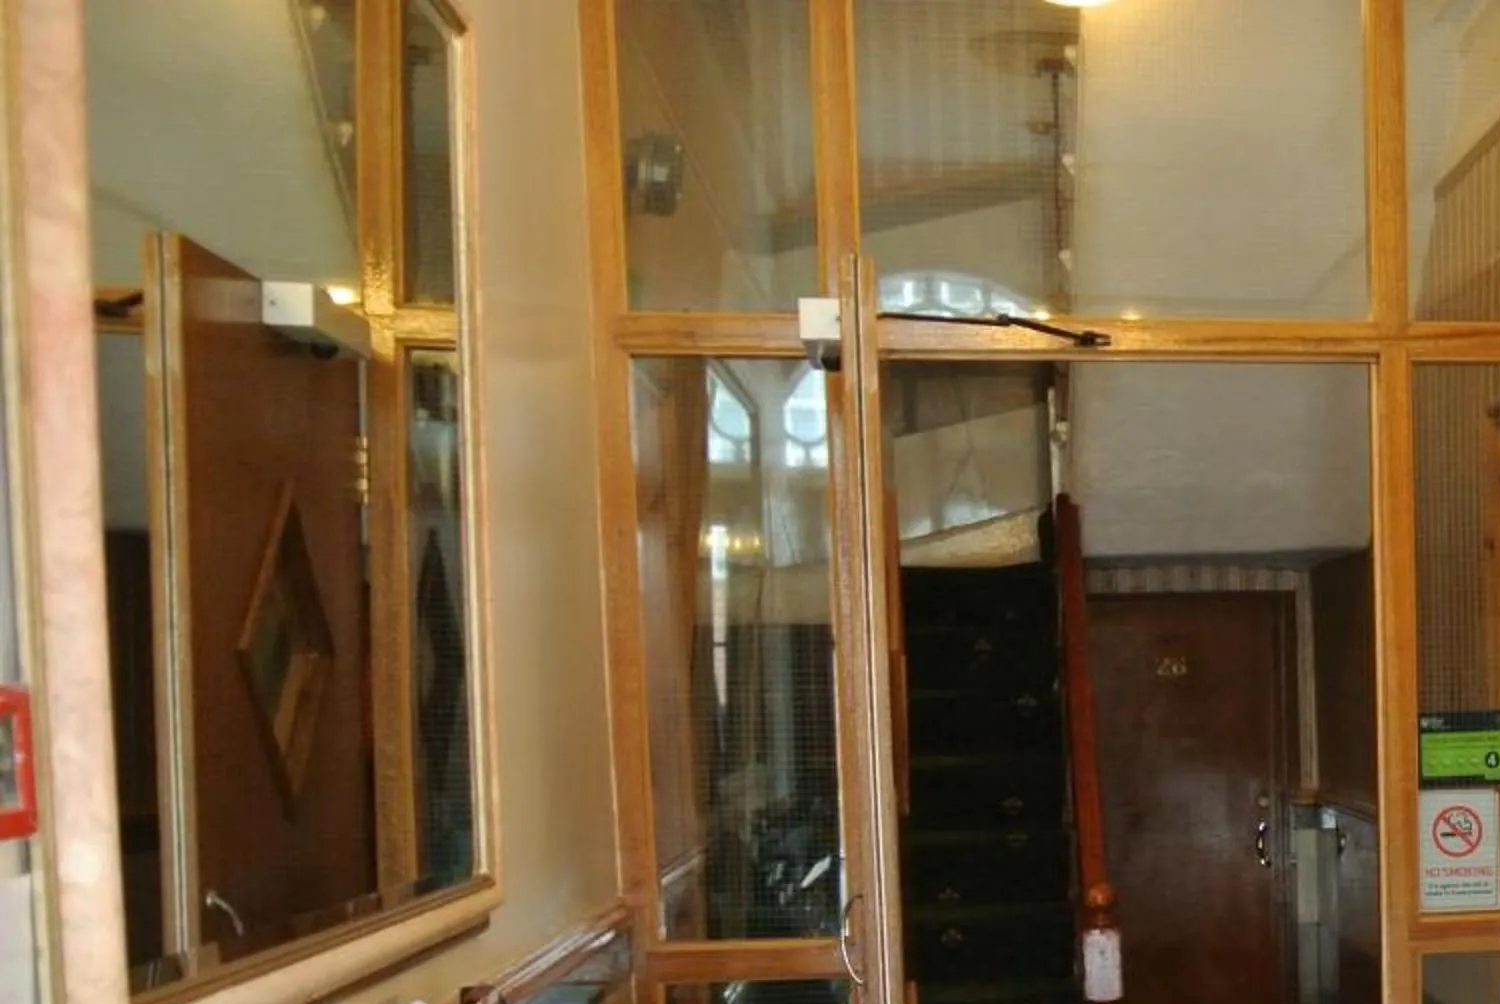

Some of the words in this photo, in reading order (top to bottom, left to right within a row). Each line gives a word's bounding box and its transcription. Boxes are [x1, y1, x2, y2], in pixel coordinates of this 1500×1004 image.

[1155, 655, 1187, 676] 26
[1487, 752, 1498, 767] 4
[1425, 866, 1440, 878] NO
[1441, 865, 1494, 878] SMOKING
